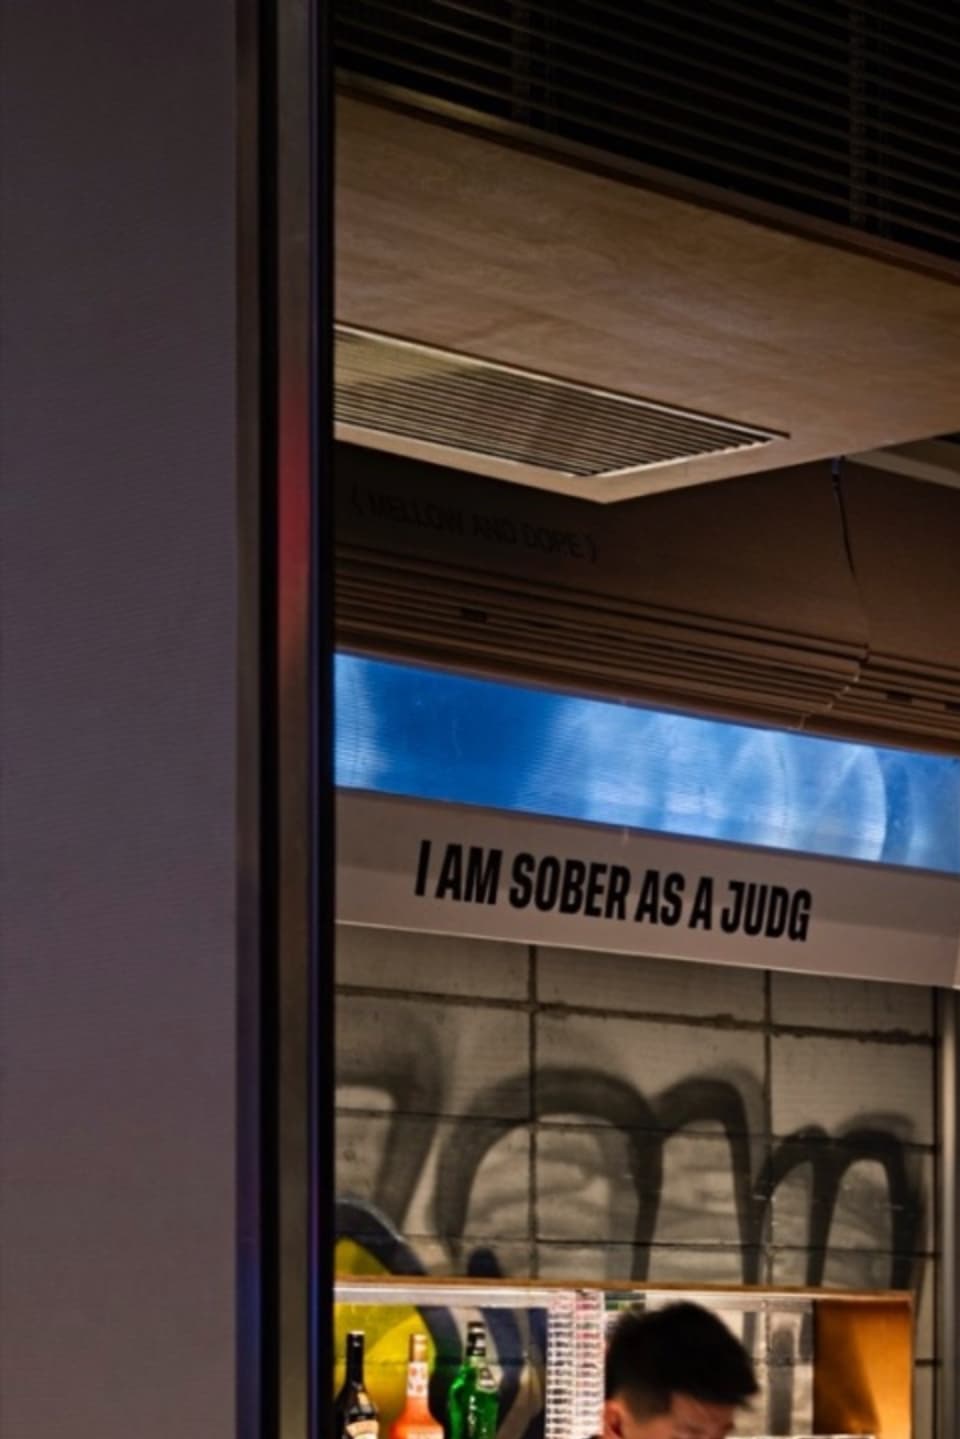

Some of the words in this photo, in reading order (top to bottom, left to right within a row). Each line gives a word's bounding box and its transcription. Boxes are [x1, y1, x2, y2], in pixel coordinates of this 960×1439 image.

[414, 839, 431, 896] I
[435, 843, 502, 904] AM
[509, 852, 631, 920] SOBER
[634, 869, 685, 926] AS
[688, 877, 713, 930] A
[720, 880, 812, 941] JUDG
